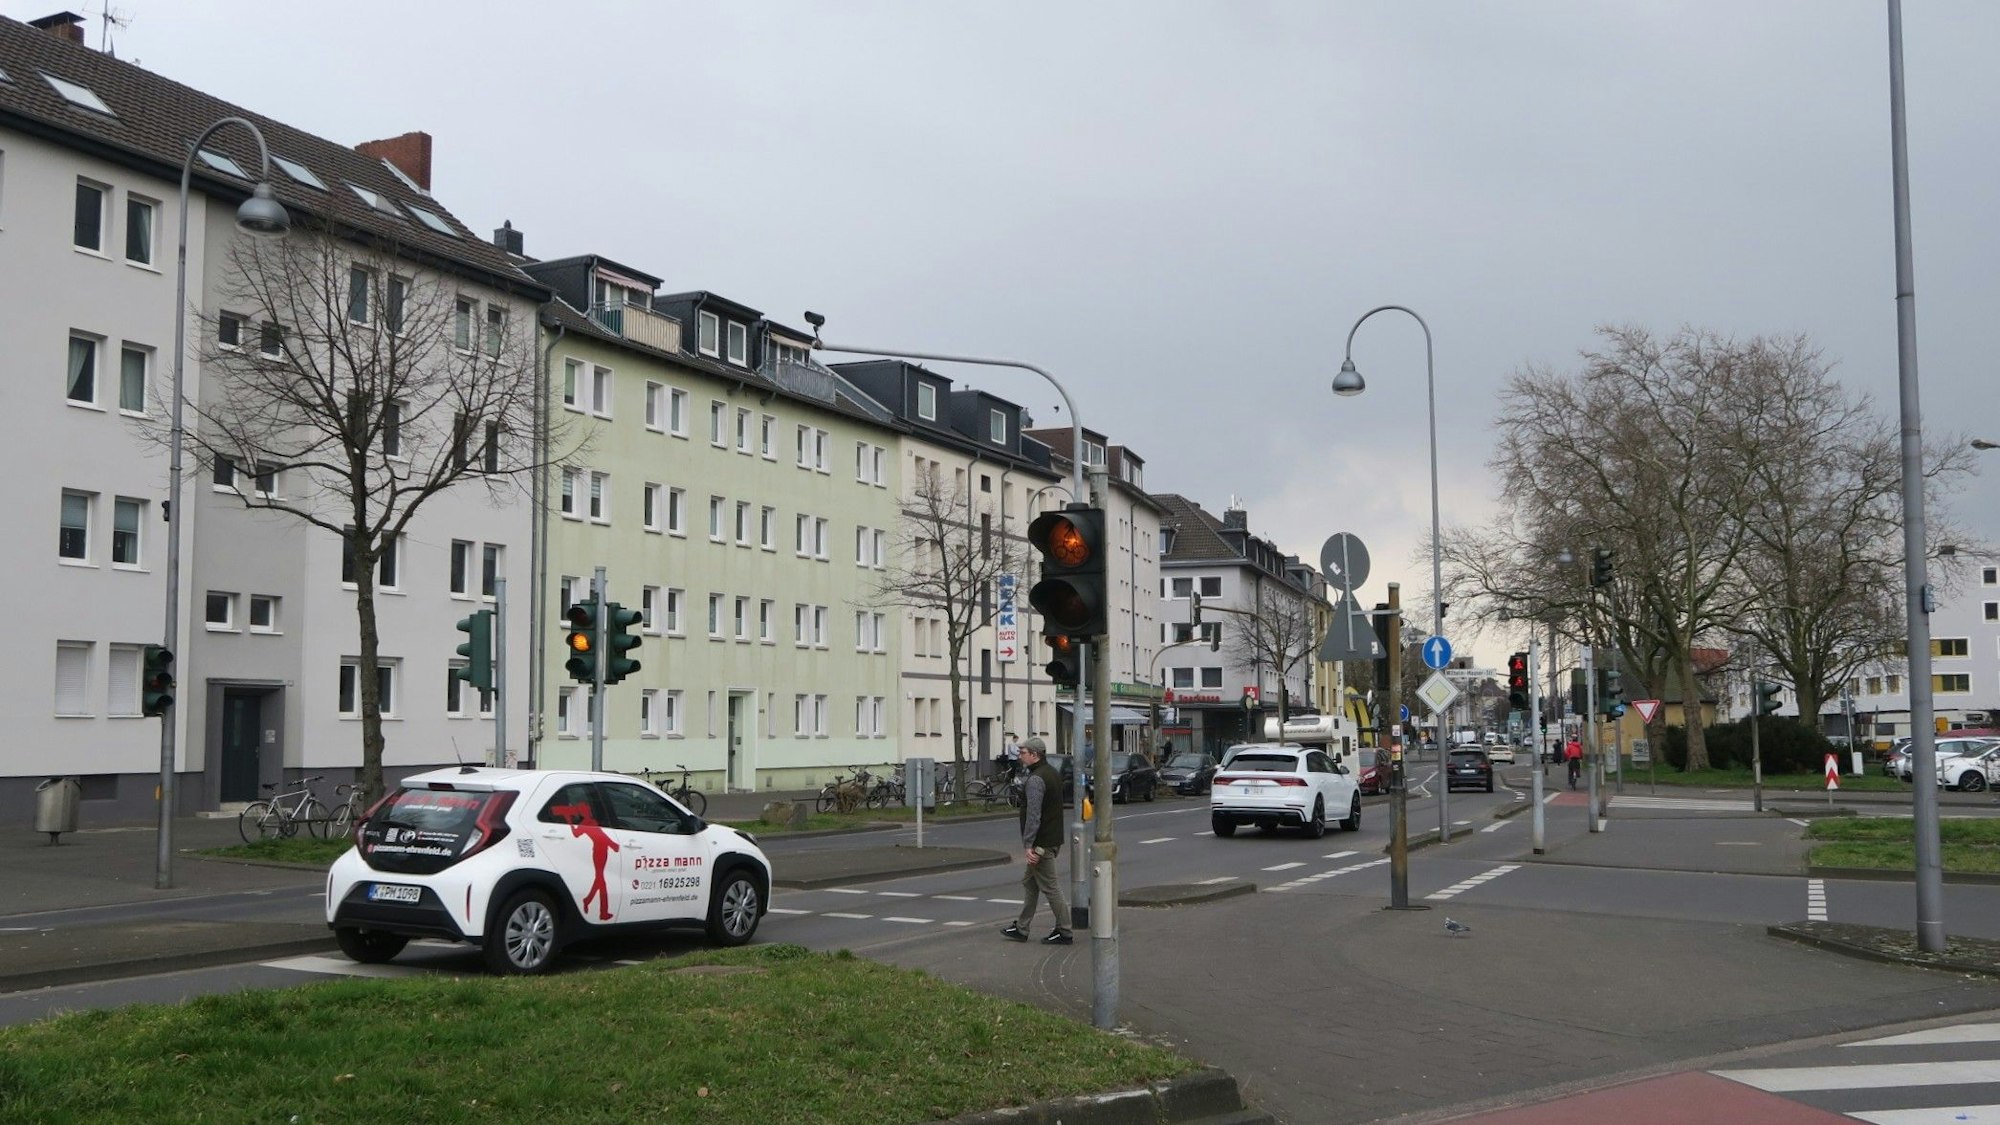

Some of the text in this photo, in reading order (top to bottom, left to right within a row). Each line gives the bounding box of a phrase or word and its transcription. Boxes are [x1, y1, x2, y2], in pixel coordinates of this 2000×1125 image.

[373, 844, 452, 857] pizzamann-ehrenfeld.de
[635, 856, 702, 870] pizza mann
[641, 876, 701, 890] 0221 16925298
[630, 894, 698, 906] pizzamann-ehrenfeld.de
